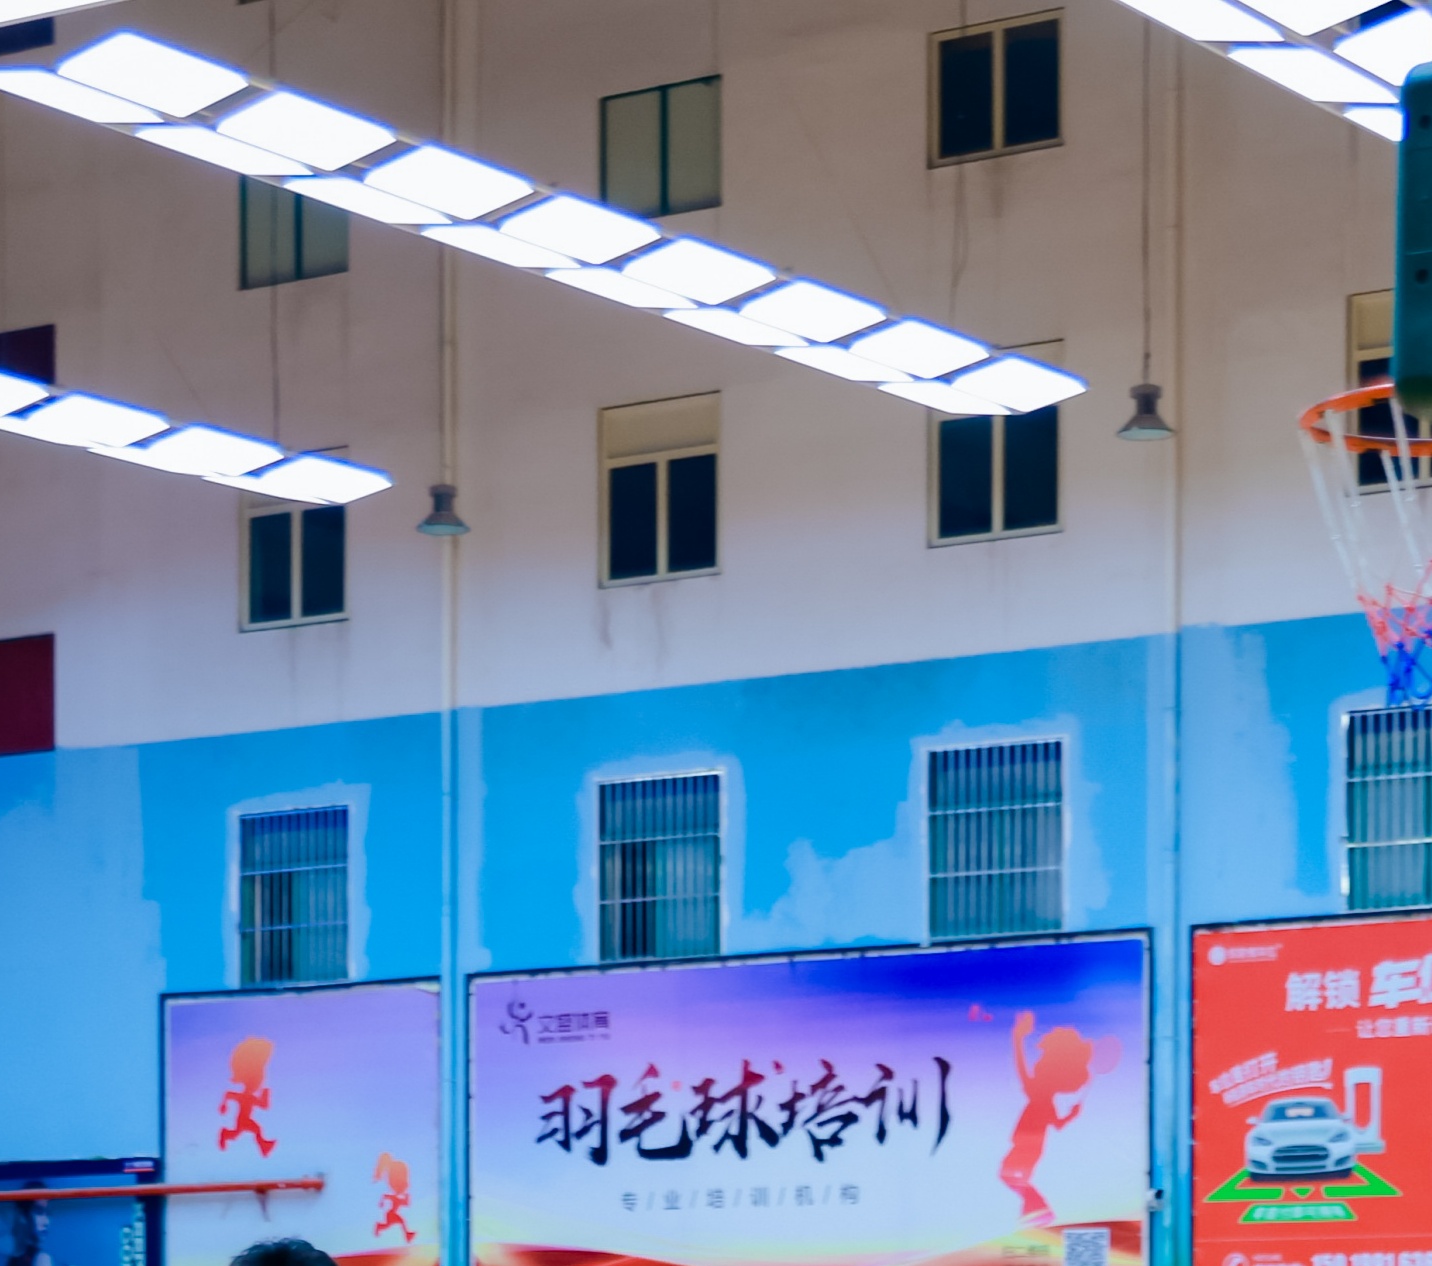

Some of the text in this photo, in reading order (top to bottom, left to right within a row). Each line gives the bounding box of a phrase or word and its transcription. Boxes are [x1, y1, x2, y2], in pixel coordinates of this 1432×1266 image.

[1284, 971, 1362, 1013] 解锁
[535, 1056, 955, 1168] 羽毛球培训
